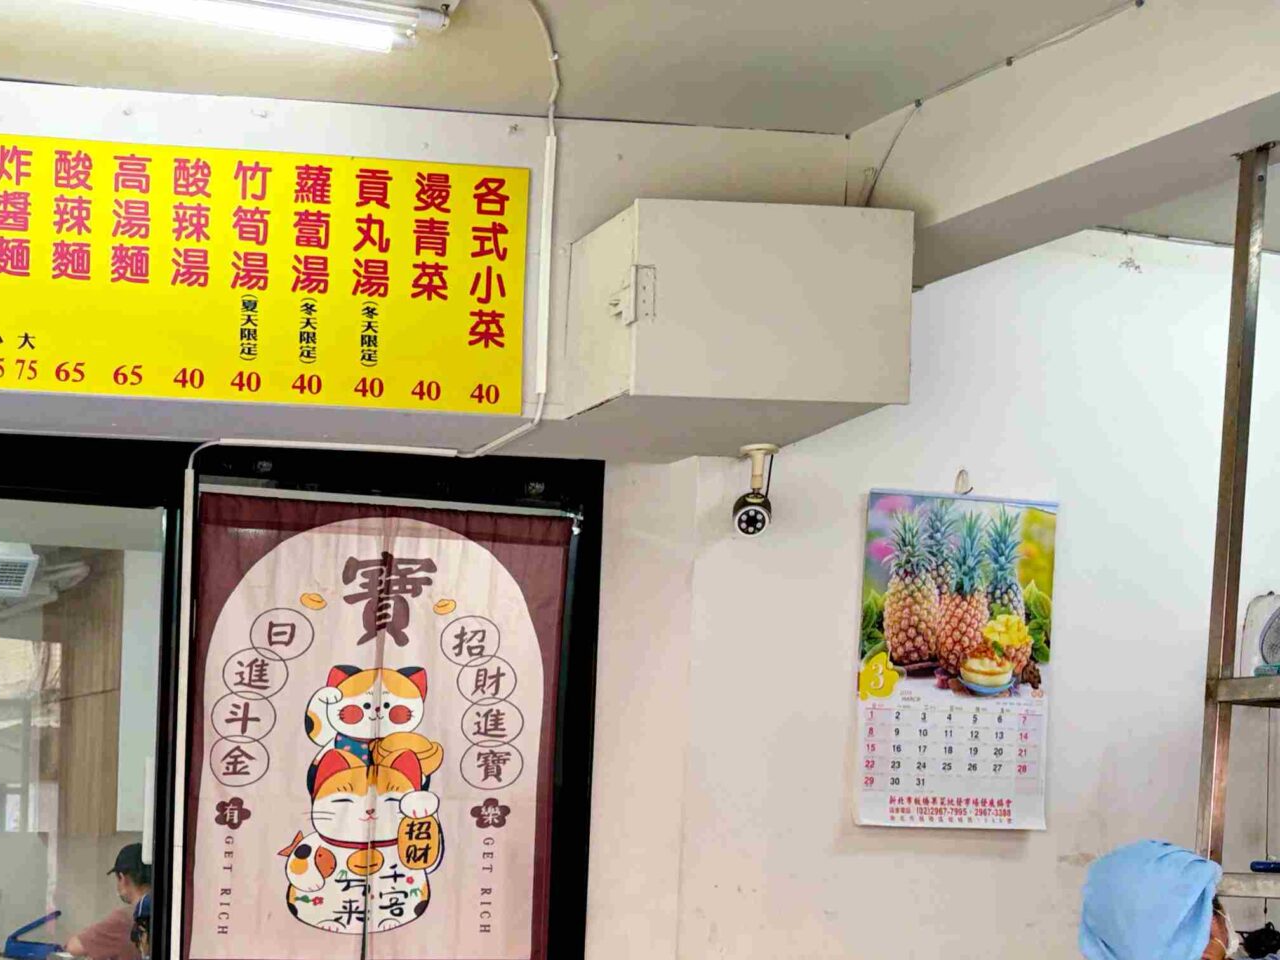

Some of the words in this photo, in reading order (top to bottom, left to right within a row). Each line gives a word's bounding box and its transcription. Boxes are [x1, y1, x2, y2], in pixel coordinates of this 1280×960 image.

[52, 150, 93, 281] 酸辣麵
[110, 154, 152, 284] 高湯麵
[171, 158, 211, 288] 酸辣湯
[230, 161, 272, 291] 竹筍湯
[291, 165, 333, 294] 蘿蔔湯
[352, 168, 393, 299] 貢丸湯
[410, 172, 451, 301] 燙青菜
[467, 177, 509, 349] 各式小菜
[17, 333, 36, 350] 大
[16, 358, 38, 381] 75
[55, 362, 85, 383] 65
[113, 364, 143, 386] 65
[173, 368, 204, 389] 40
[230, 370, 261, 393] 40
[291, 374, 322, 395] 40
[354, 376, 384, 398] 40
[411, 380, 441, 401] 40
[470, 383, 500, 404] 40
[342, 551, 438, 647] 寶
[871, 663, 885, 690] 3
[452, 625, 512, 783] 招財進寶
[919, 729, 928, 737] 10
[970, 731, 979, 739] 12
[995, 731, 1004, 740] 13
[1020, 733, 1029, 741] 14
[918, 745, 927, 753] 17
[944, 746, 953, 754] 18
[969, 747, 978, 755] 19
[993, 748, 1003, 756] 20
[1018, 749, 1027, 757] 21
[864, 760, 875, 768] 22
[891, 761, 901, 769] 23
[917, 762, 926, 770] 24
[942, 762, 952, 771] 25
[968, 763, 977, 771] 26
[992, 764, 1002, 772] 27
[1017, 765, 1027, 773] 28
[864, 777, 874, 785] 29
[890, 777, 900, 785] 30
[916, 778, 925, 786] 31
[223, 835, 234, 872] GET
[482, 836, 494, 873] GET
[217, 888, 231, 935] RICH
[479, 887, 492, 933] RICH
